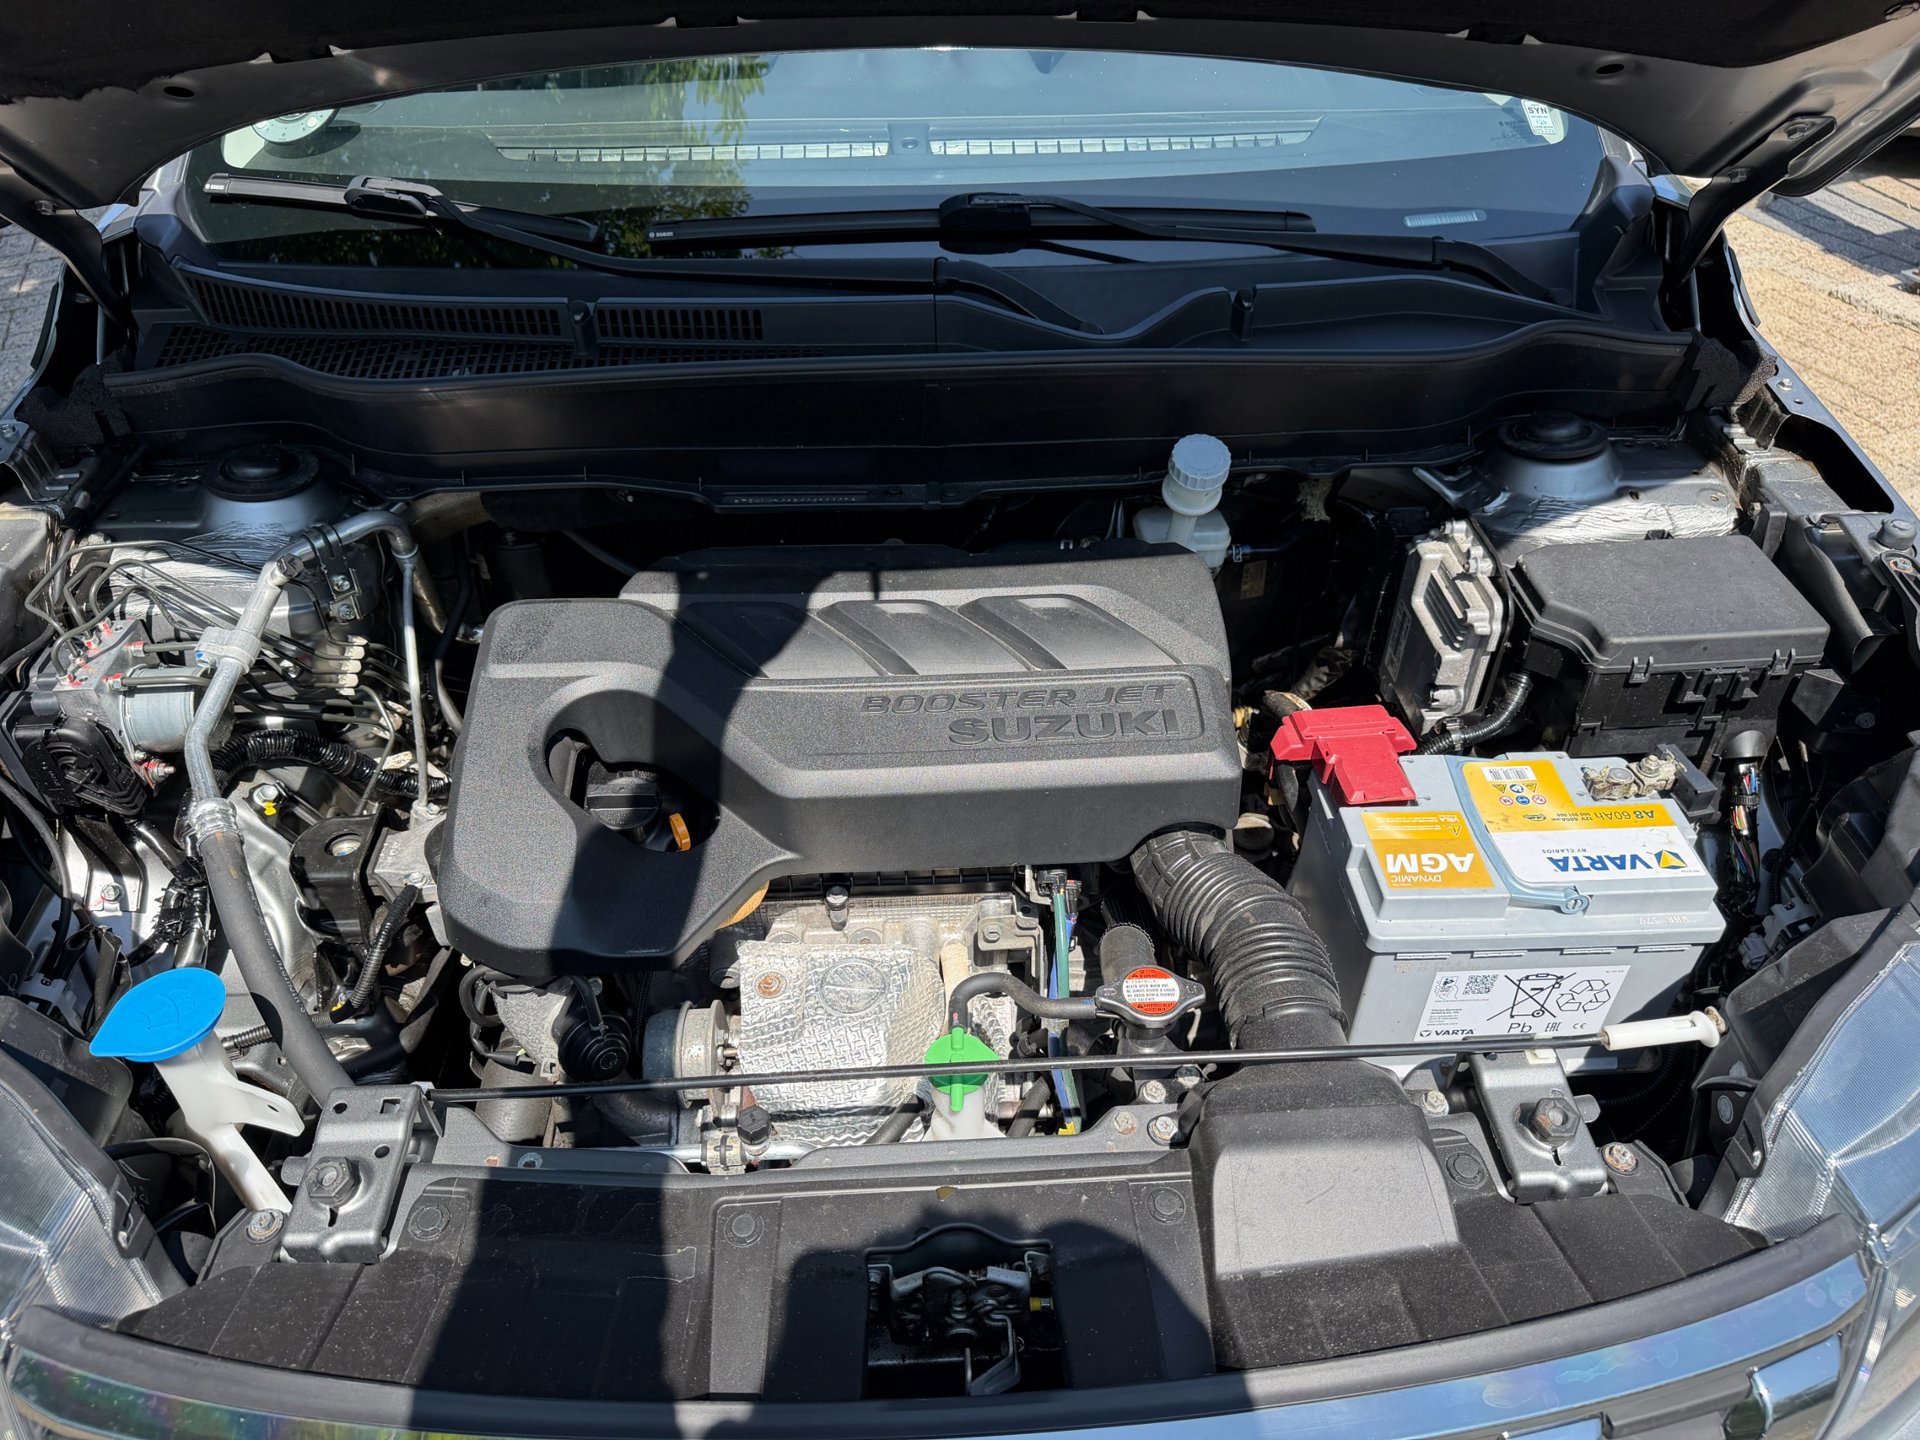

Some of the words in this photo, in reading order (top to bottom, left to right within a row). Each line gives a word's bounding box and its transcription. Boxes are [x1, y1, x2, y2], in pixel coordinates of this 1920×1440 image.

[1527, 106, 1548, 115] SYN
[861, 688, 1079, 715] BOOSTER
[1085, 684, 1176, 708] JET
[948, 708, 1181, 746] SUZUKI
[1594, 810, 1630, 821] 60Ah
[1633, 809, 1655, 820] A8
[1385, 852, 1474, 874] AGM
[1548, 854, 1653, 873] VARTA
[1390, 875, 1442, 883] DYNAMIC
[1434, 1028, 1475, 1037] VARTA
[1507, 1022, 1533, 1034] Pb
